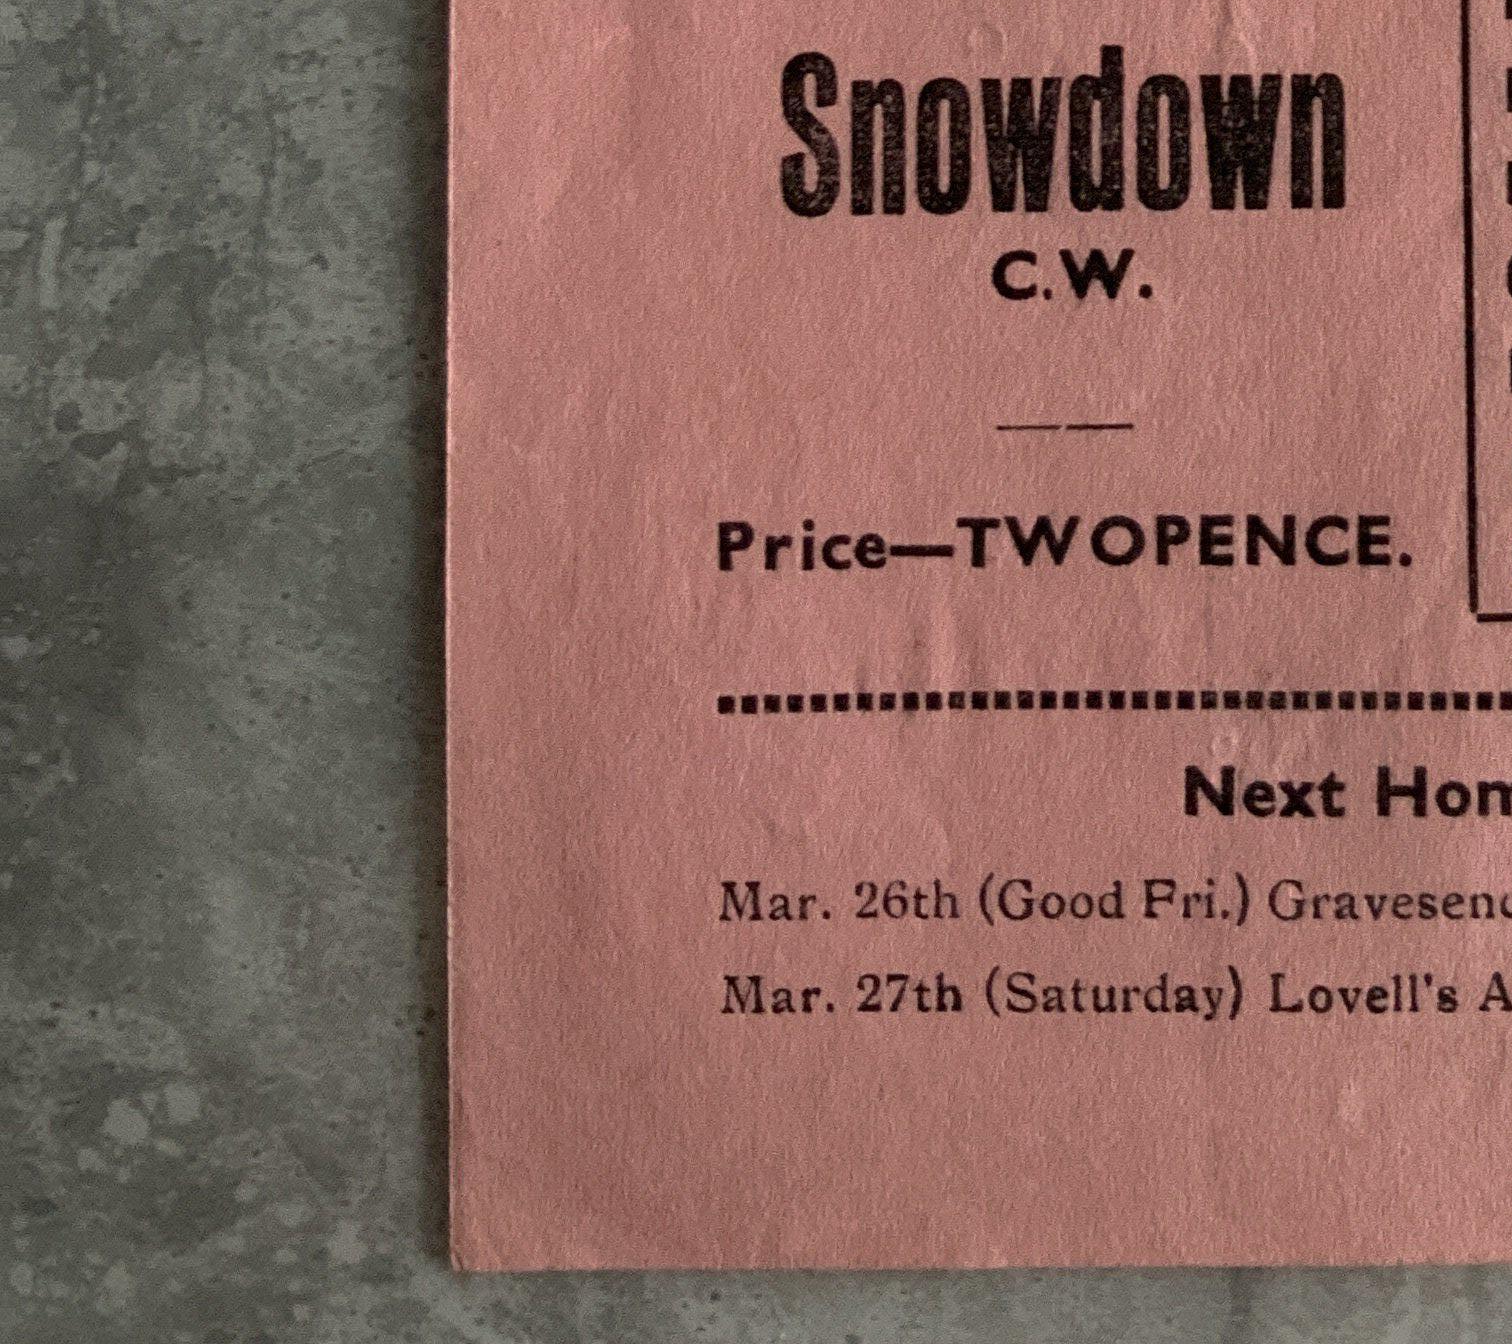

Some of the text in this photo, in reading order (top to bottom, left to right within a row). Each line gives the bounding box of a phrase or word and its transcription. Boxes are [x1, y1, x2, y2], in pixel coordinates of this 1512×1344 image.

[780, 45, 1345, 218] Snowdown
[992, 248, 1152, 300] C.W.
[1185, 766, 1345, 818] Next
[720, 881, 830, 921] Mar.
[855, 879, 960, 920] 26th
[979, 873, 1125, 926] (Good
[1144, 872, 1249, 926] Fri.)
[721, 975, 834, 1014] Mar.
[857, 973, 962, 1012] 27th
[986, 965, 1242, 1021] (Saturday)
[1269, 973, 1458, 1014] Lovell's
